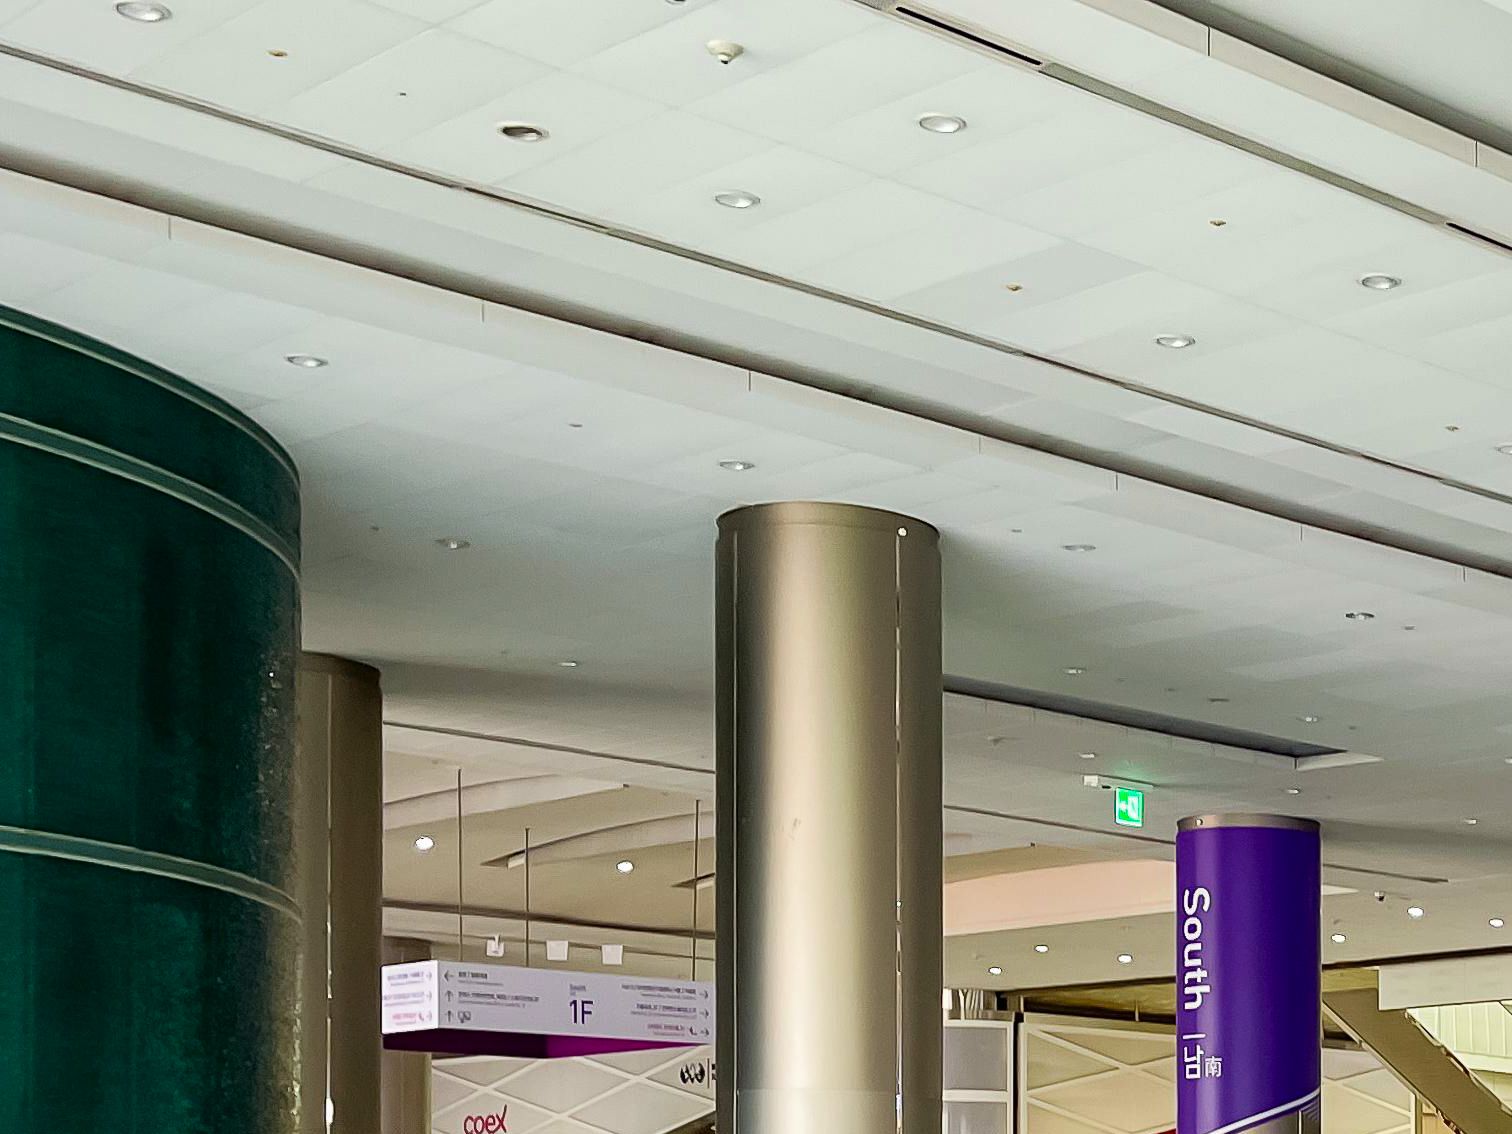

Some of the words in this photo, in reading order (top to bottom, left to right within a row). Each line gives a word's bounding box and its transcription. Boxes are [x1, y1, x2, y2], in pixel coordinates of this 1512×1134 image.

[1183, 887, 1211, 1010] South
[569, 999, 594, 1025] 1F
[1183, 1044, 1205, 1079] 남
[1204, 1056, 1223, 1078] 南
